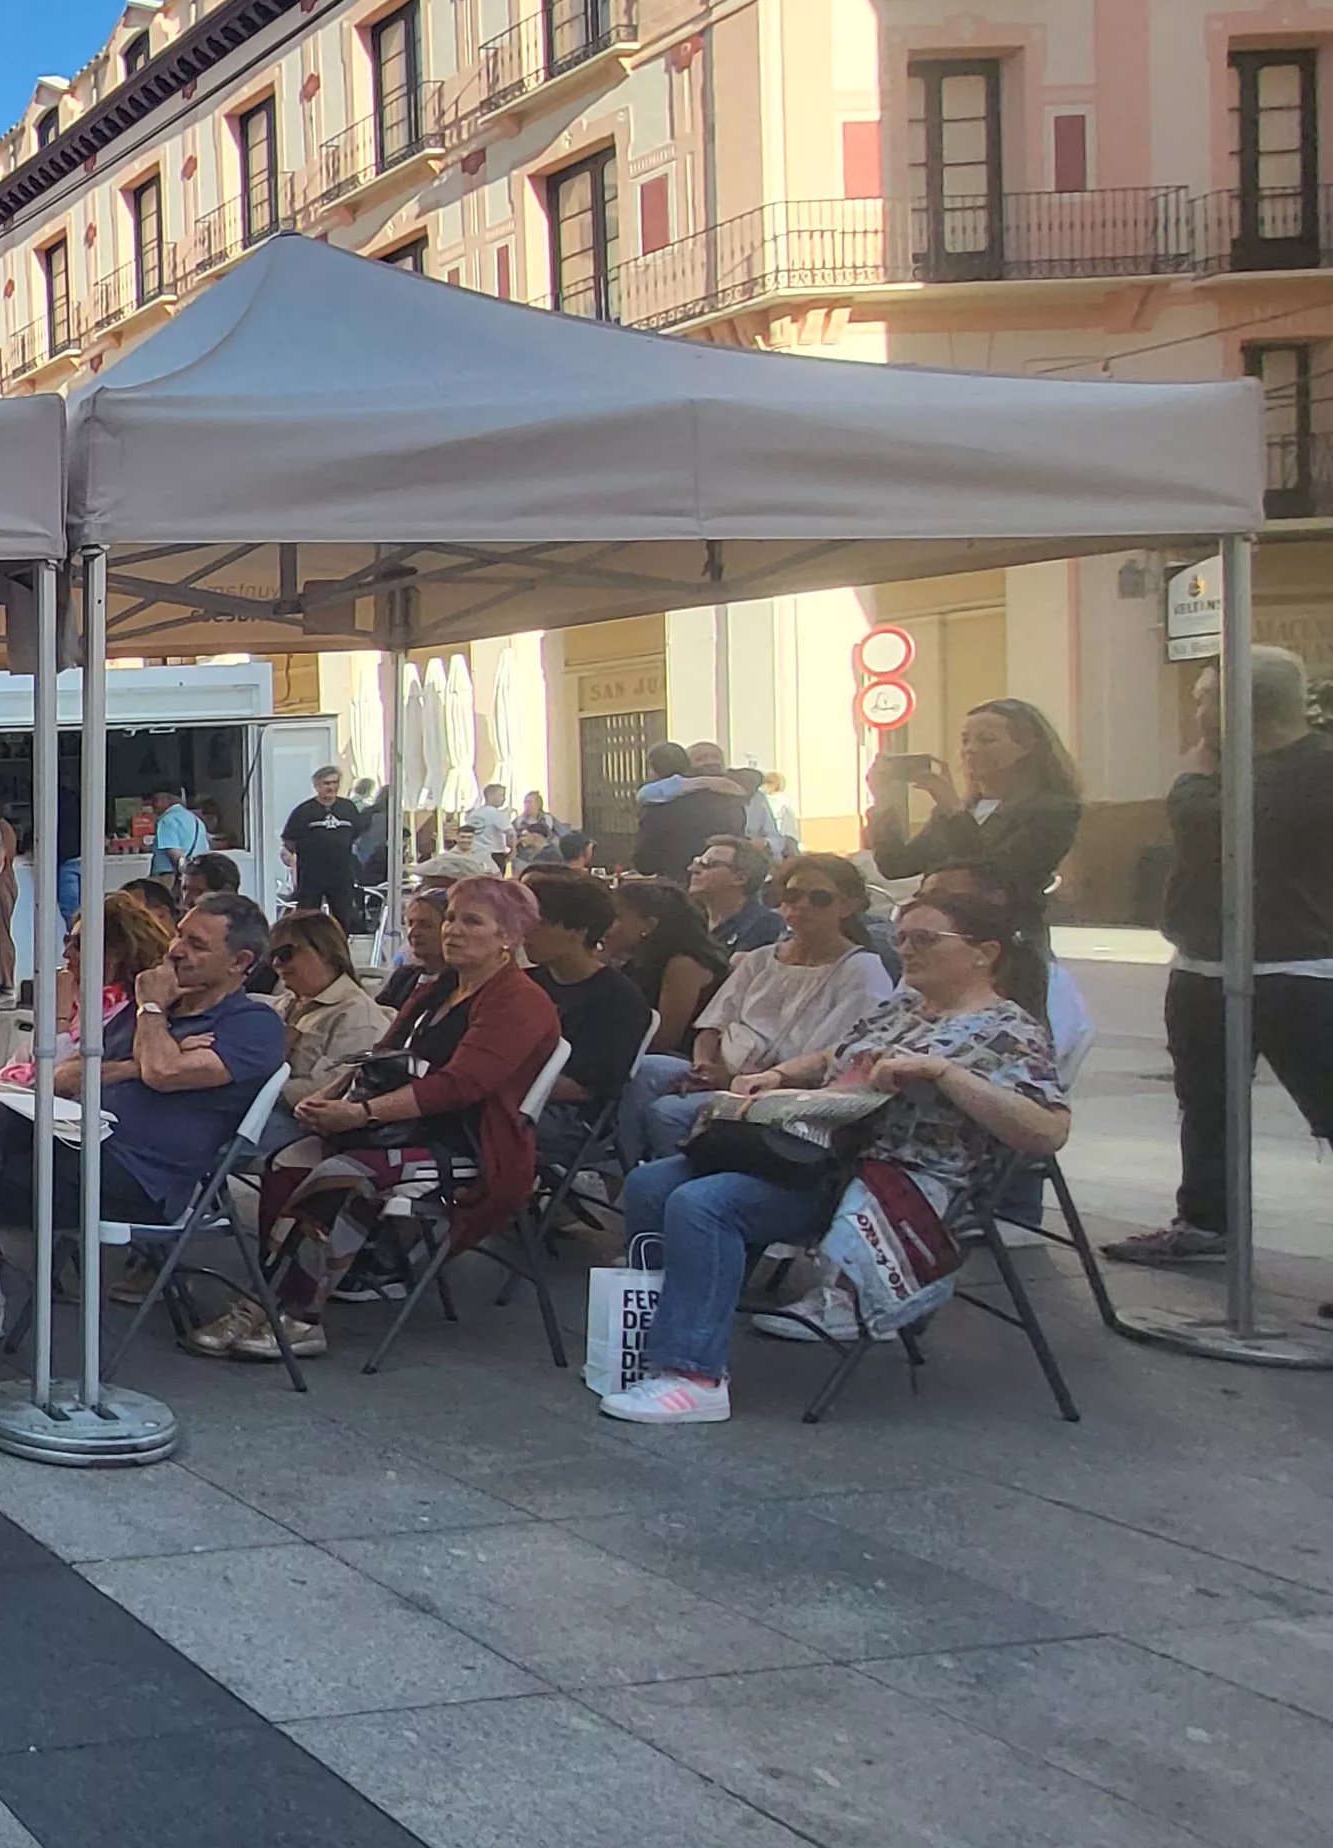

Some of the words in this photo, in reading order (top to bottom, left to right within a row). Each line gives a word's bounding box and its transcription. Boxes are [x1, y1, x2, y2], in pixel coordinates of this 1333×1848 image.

[590, 681, 625, 701] SAN
[633, 677, 663, 696] JU
[623, 1289, 659, 1310] FER
